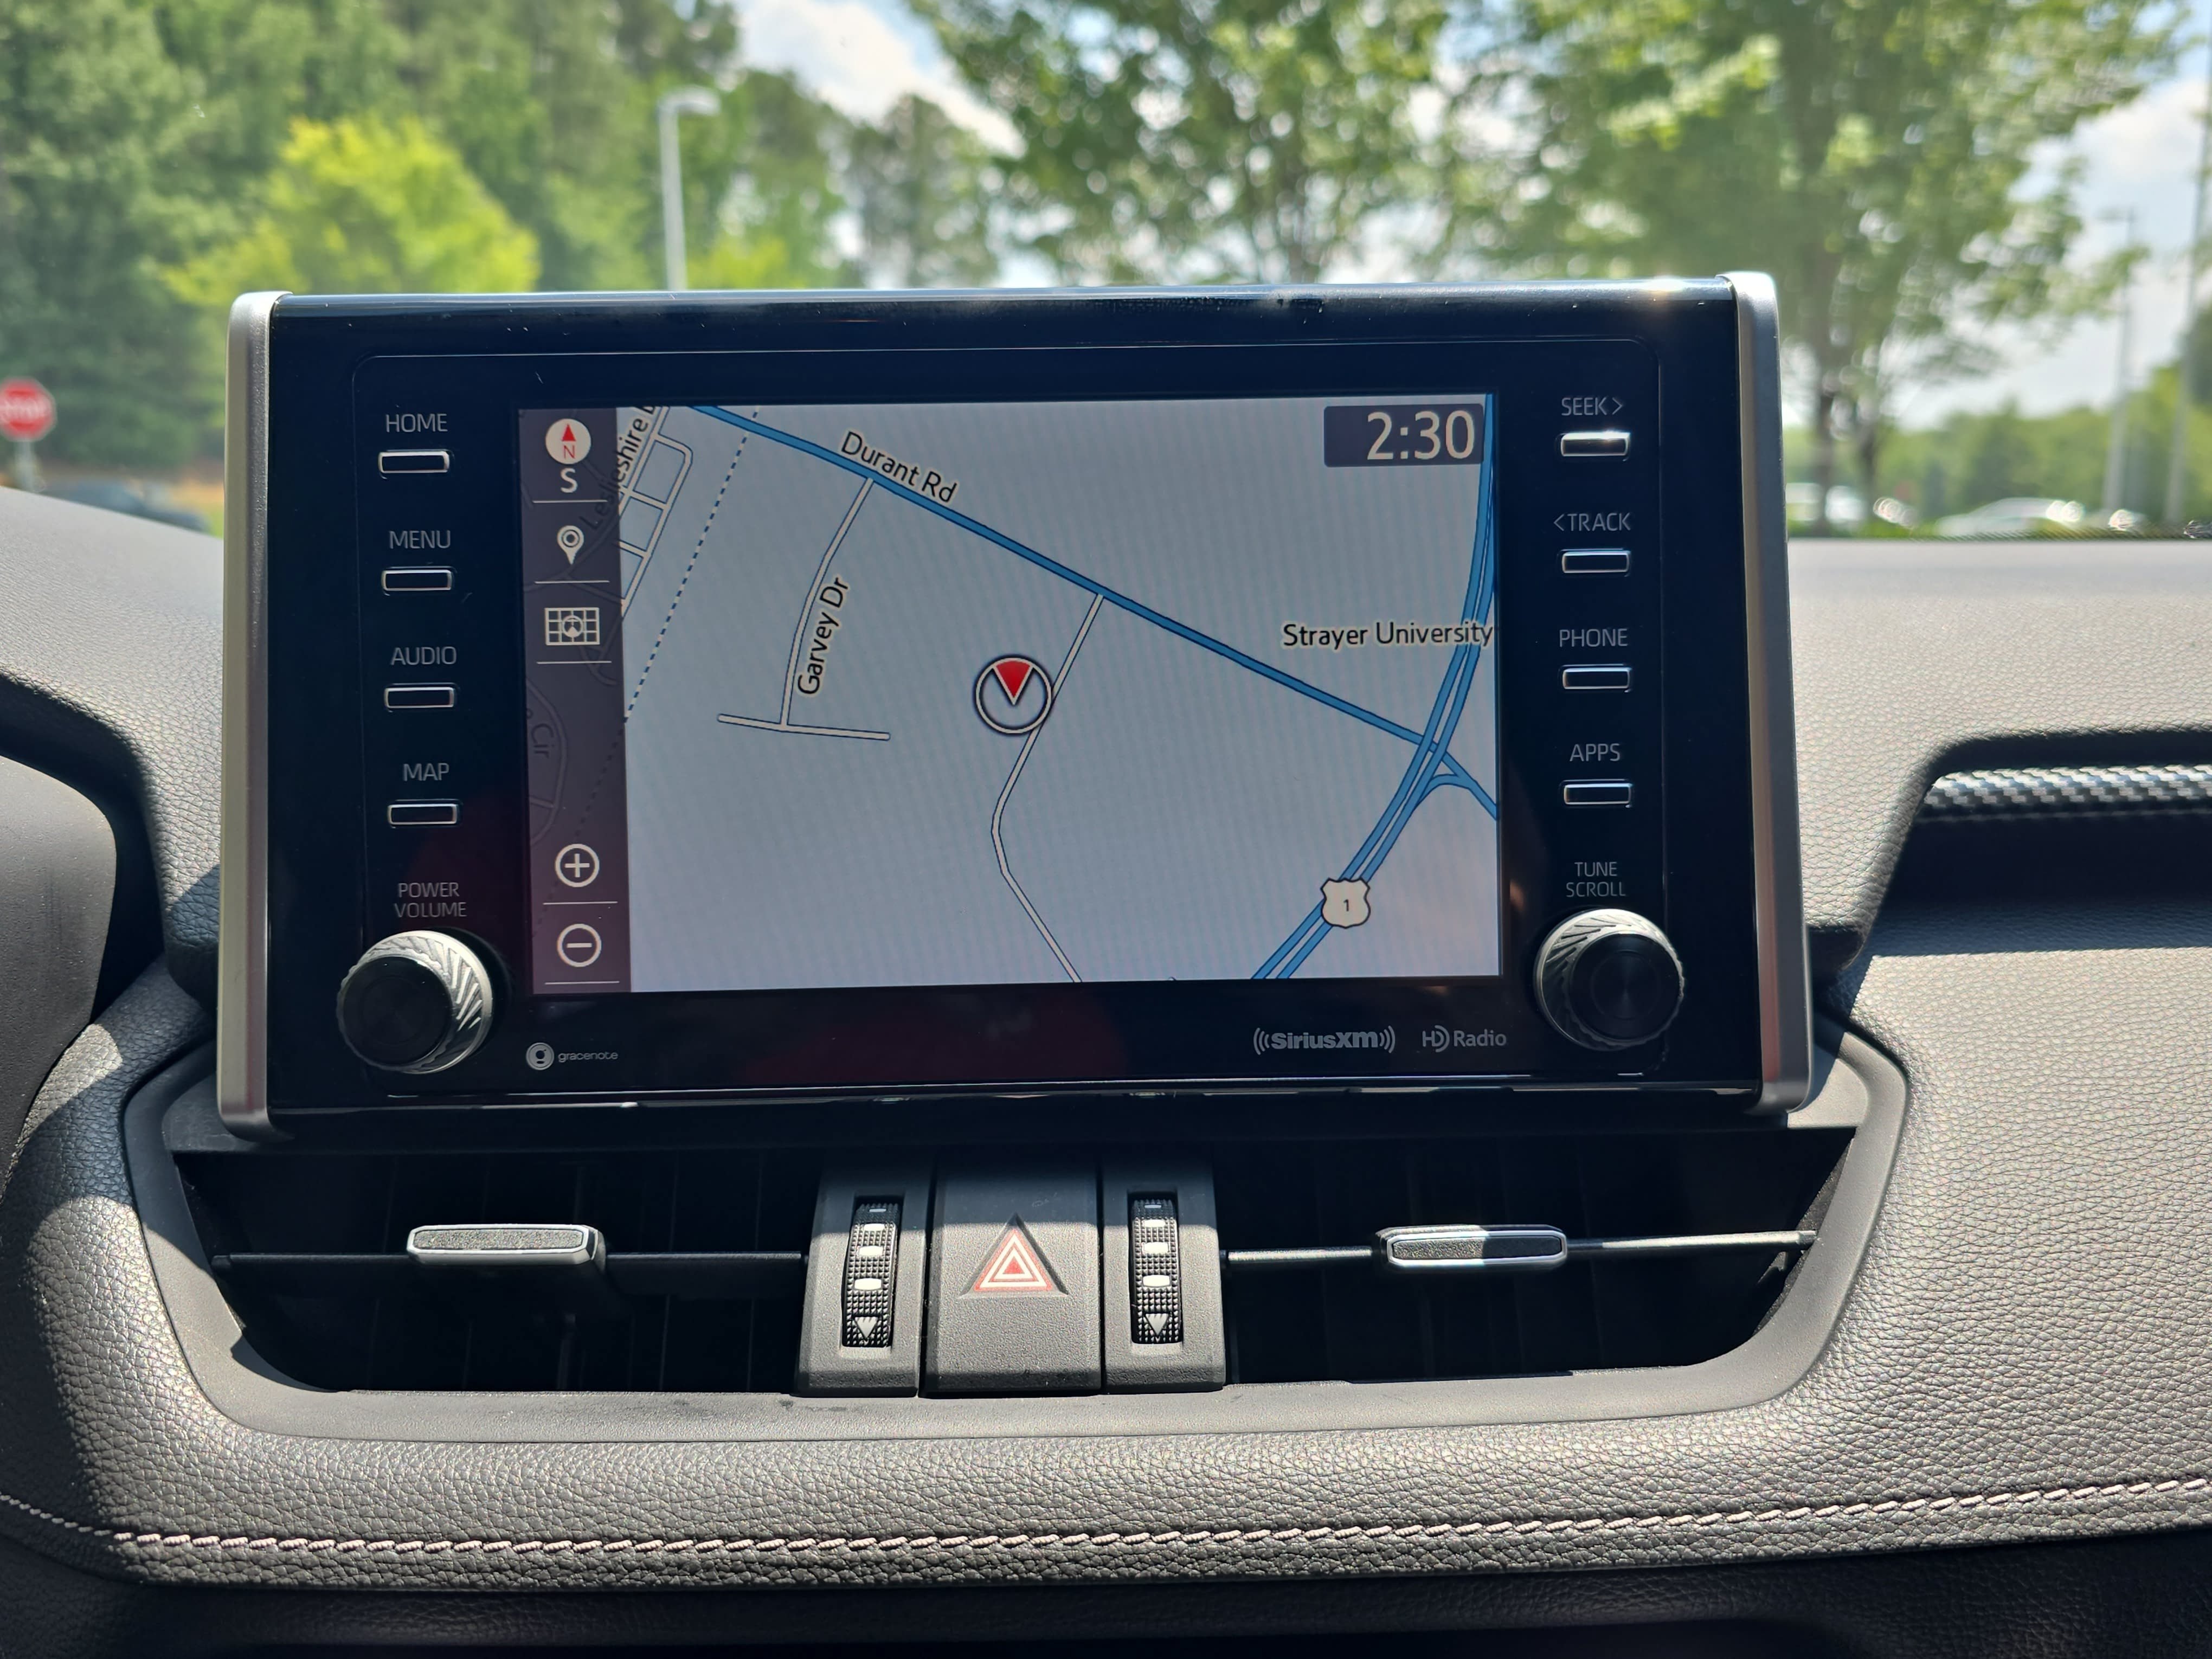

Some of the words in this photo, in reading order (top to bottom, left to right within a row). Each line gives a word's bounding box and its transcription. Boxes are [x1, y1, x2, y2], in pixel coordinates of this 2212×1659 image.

[385, 414, 448, 432] HOME
[1367, 410, 1475, 460] 2:30
[564, 445, 575, 459] N
[841, 432, 919, 486] Durant
[922, 471, 957, 503] Rd
[560, 467, 578, 493] S
[388, 530, 451, 549] MENU
[798, 612, 839, 694] Garvey
[820, 577, 849, 607] Dr
[1283, 624, 1368, 649] Strayer
[1376, 621, 1494, 647] University
[1559, 629, 1628, 647] PHONE
[390, 646, 457, 665] AUDIO
[1570, 743, 1620, 762] APPS
[402, 763, 449, 781] MAP
[1574, 861, 1617, 877] TUNE
[398, 882, 460, 898] POWER
[1566, 882, 1625, 897] SCROLL
[394, 902, 467, 918] VOLUME
[1343, 899, 1350, 912] 1
[1454, 1030, 1507, 1047] Radio
[558, 1051, 619, 1063] gracenote
